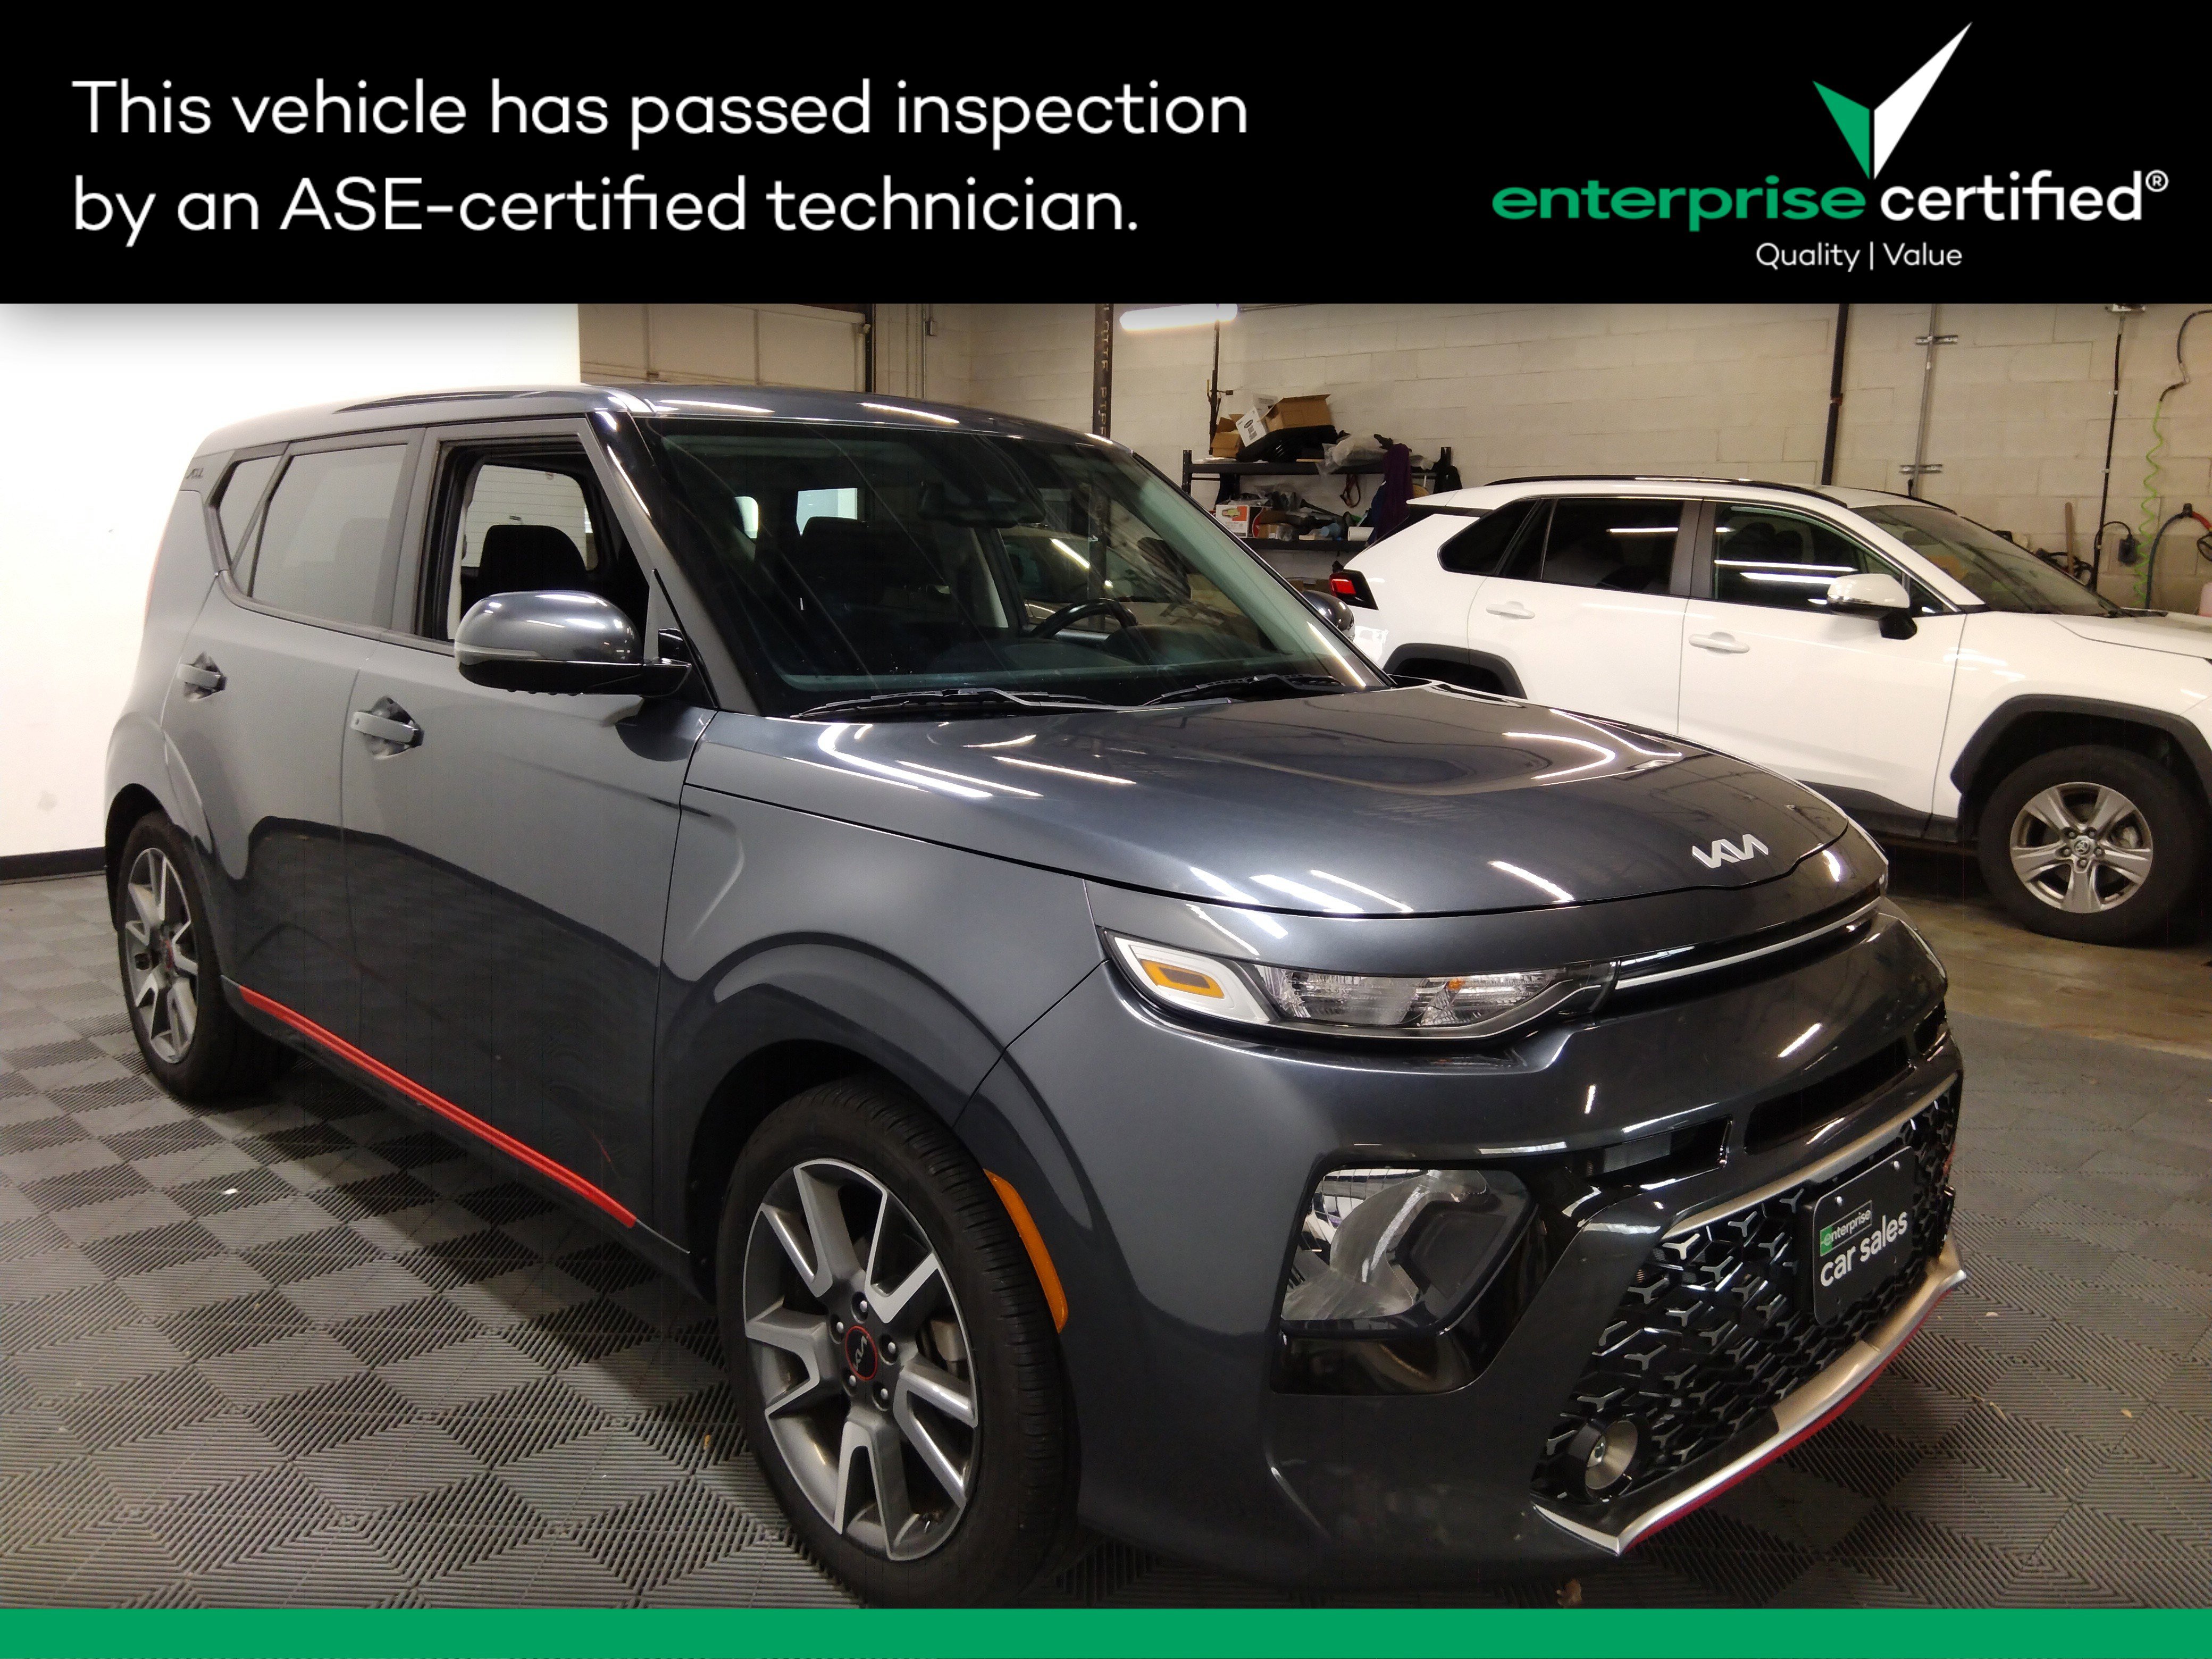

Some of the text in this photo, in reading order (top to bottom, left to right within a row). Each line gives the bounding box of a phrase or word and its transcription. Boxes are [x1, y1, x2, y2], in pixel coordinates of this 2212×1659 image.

[1821, 1211, 1907, 1287] car sales
[1822, 1210, 1871, 1246] enterprise
